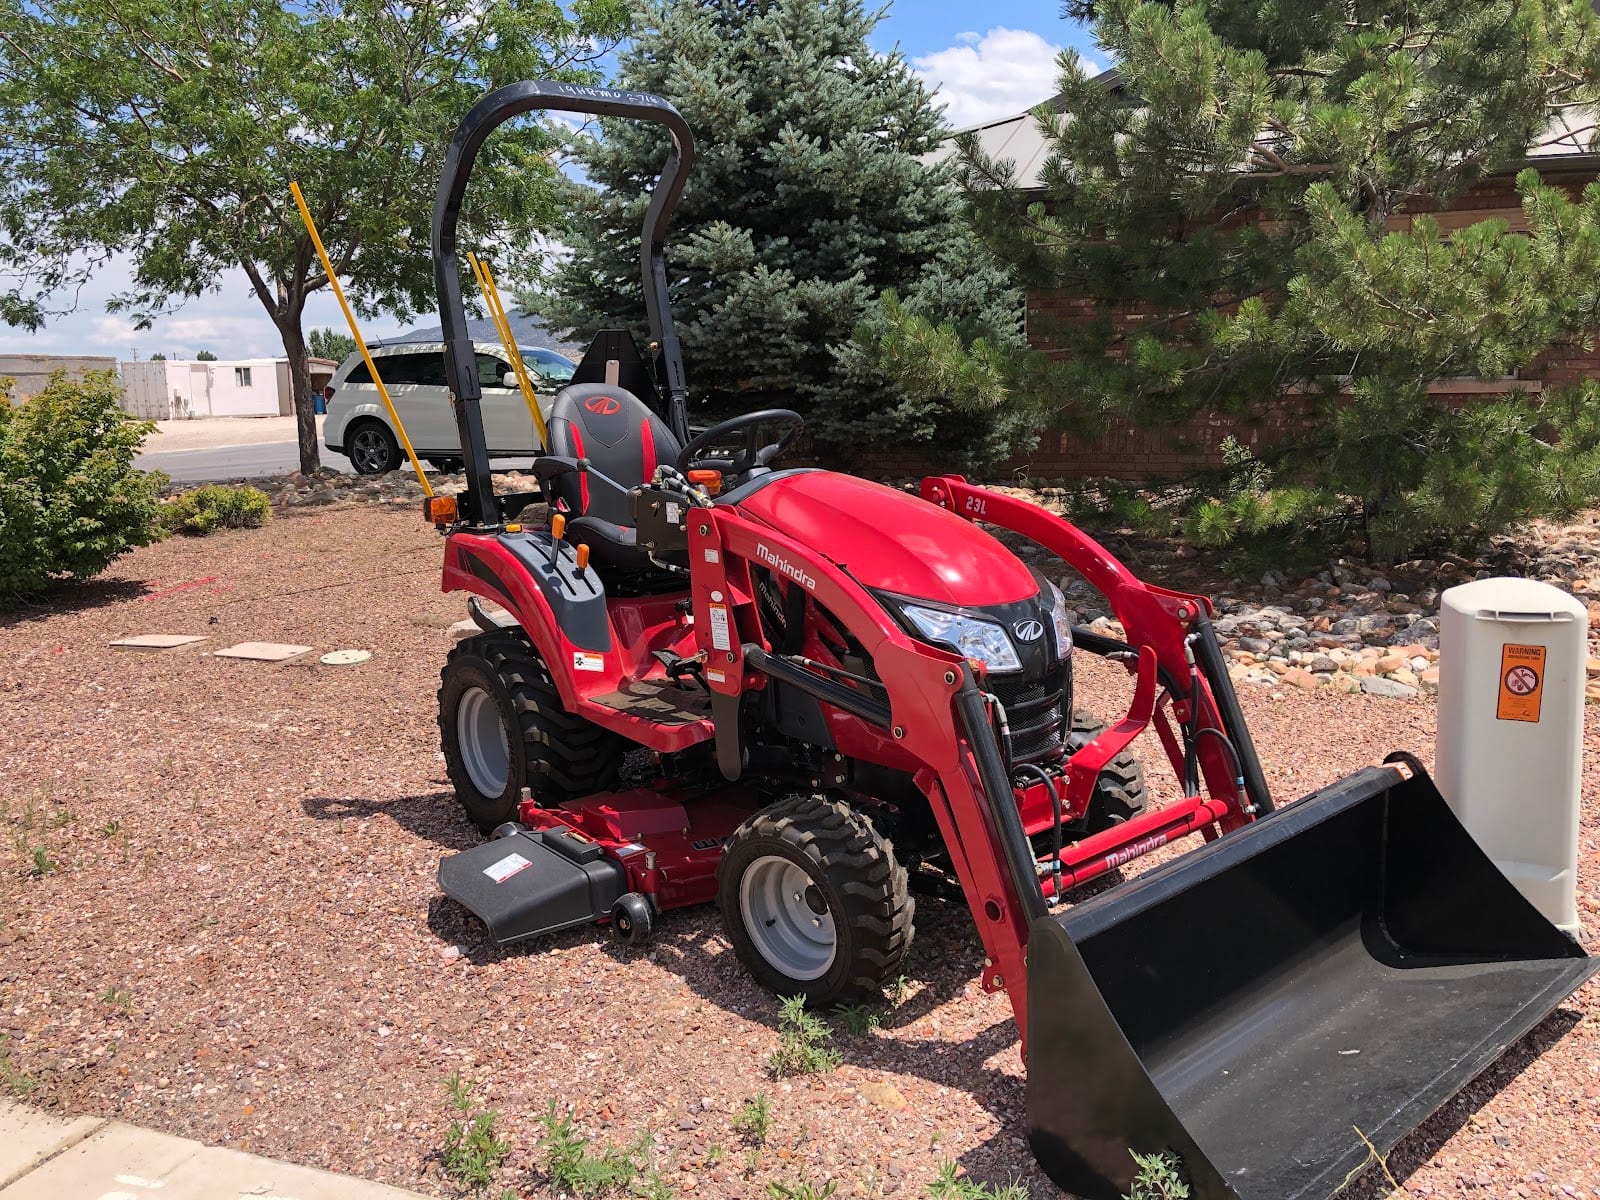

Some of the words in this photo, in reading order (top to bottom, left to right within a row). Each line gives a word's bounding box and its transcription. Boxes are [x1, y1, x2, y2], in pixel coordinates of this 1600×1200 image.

[756, 542, 816, 591] Mahindra
[1508, 647, 1541, 656] WARNING
[1105, 834, 1168, 870] Mahindra
